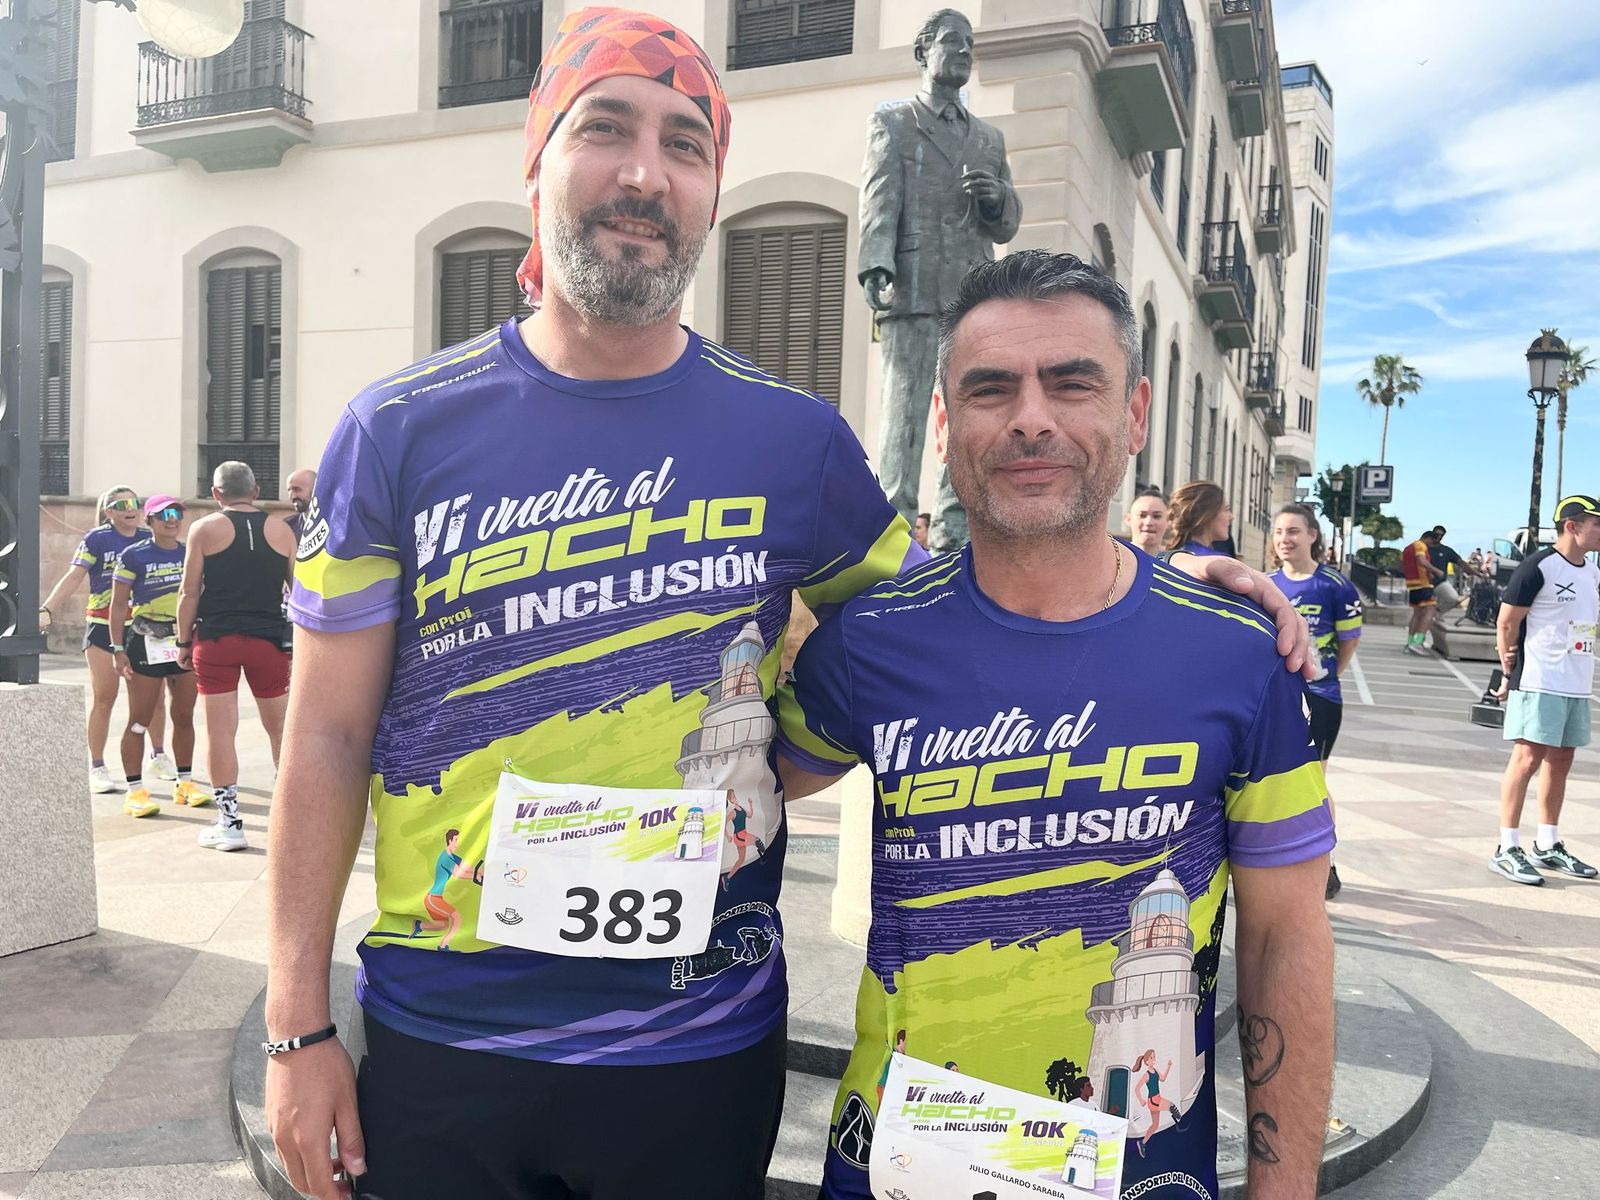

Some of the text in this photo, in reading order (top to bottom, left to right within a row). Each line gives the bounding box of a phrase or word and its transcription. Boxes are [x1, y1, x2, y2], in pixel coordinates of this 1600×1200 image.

[411, 361, 499, 396] FIREHAWK
[1367, 469, 1387, 489] P
[478, 467, 620, 540] vuelta
[624, 456, 675, 508] al
[420, 545, 768, 660] POR LA INCLUSIÓN
[885, 590, 956, 613] FIREHAWK
[419, 622, 440, 637] con
[920, 706, 1041, 767] vuelta
[1044, 700, 1097, 750] al
[543, 800, 585, 817] vuelta
[585, 797, 602, 811] al
[639, 806, 678, 830] 10K
[527, 837, 546, 846] POR
[560, 821, 627, 842] INCLUSIÓN
[884, 795, 1194, 860] POR LA INCLUSIÓN
[559, 886, 683, 945] 383
[929, 1089, 969, 1105] vuelta
[969, 1091, 985, 1105] al
[913, 1121, 1008, 1133] POR LA INCLUSIÓN
[1020, 1120, 1068, 1138] 10K
[969, 1164, 1065, 1200] JULIO GALLARDO SARABIA
[1121, 1173, 1171, 1200] ANSPORTES
[1172, 1172, 1186, 1184] DEL
